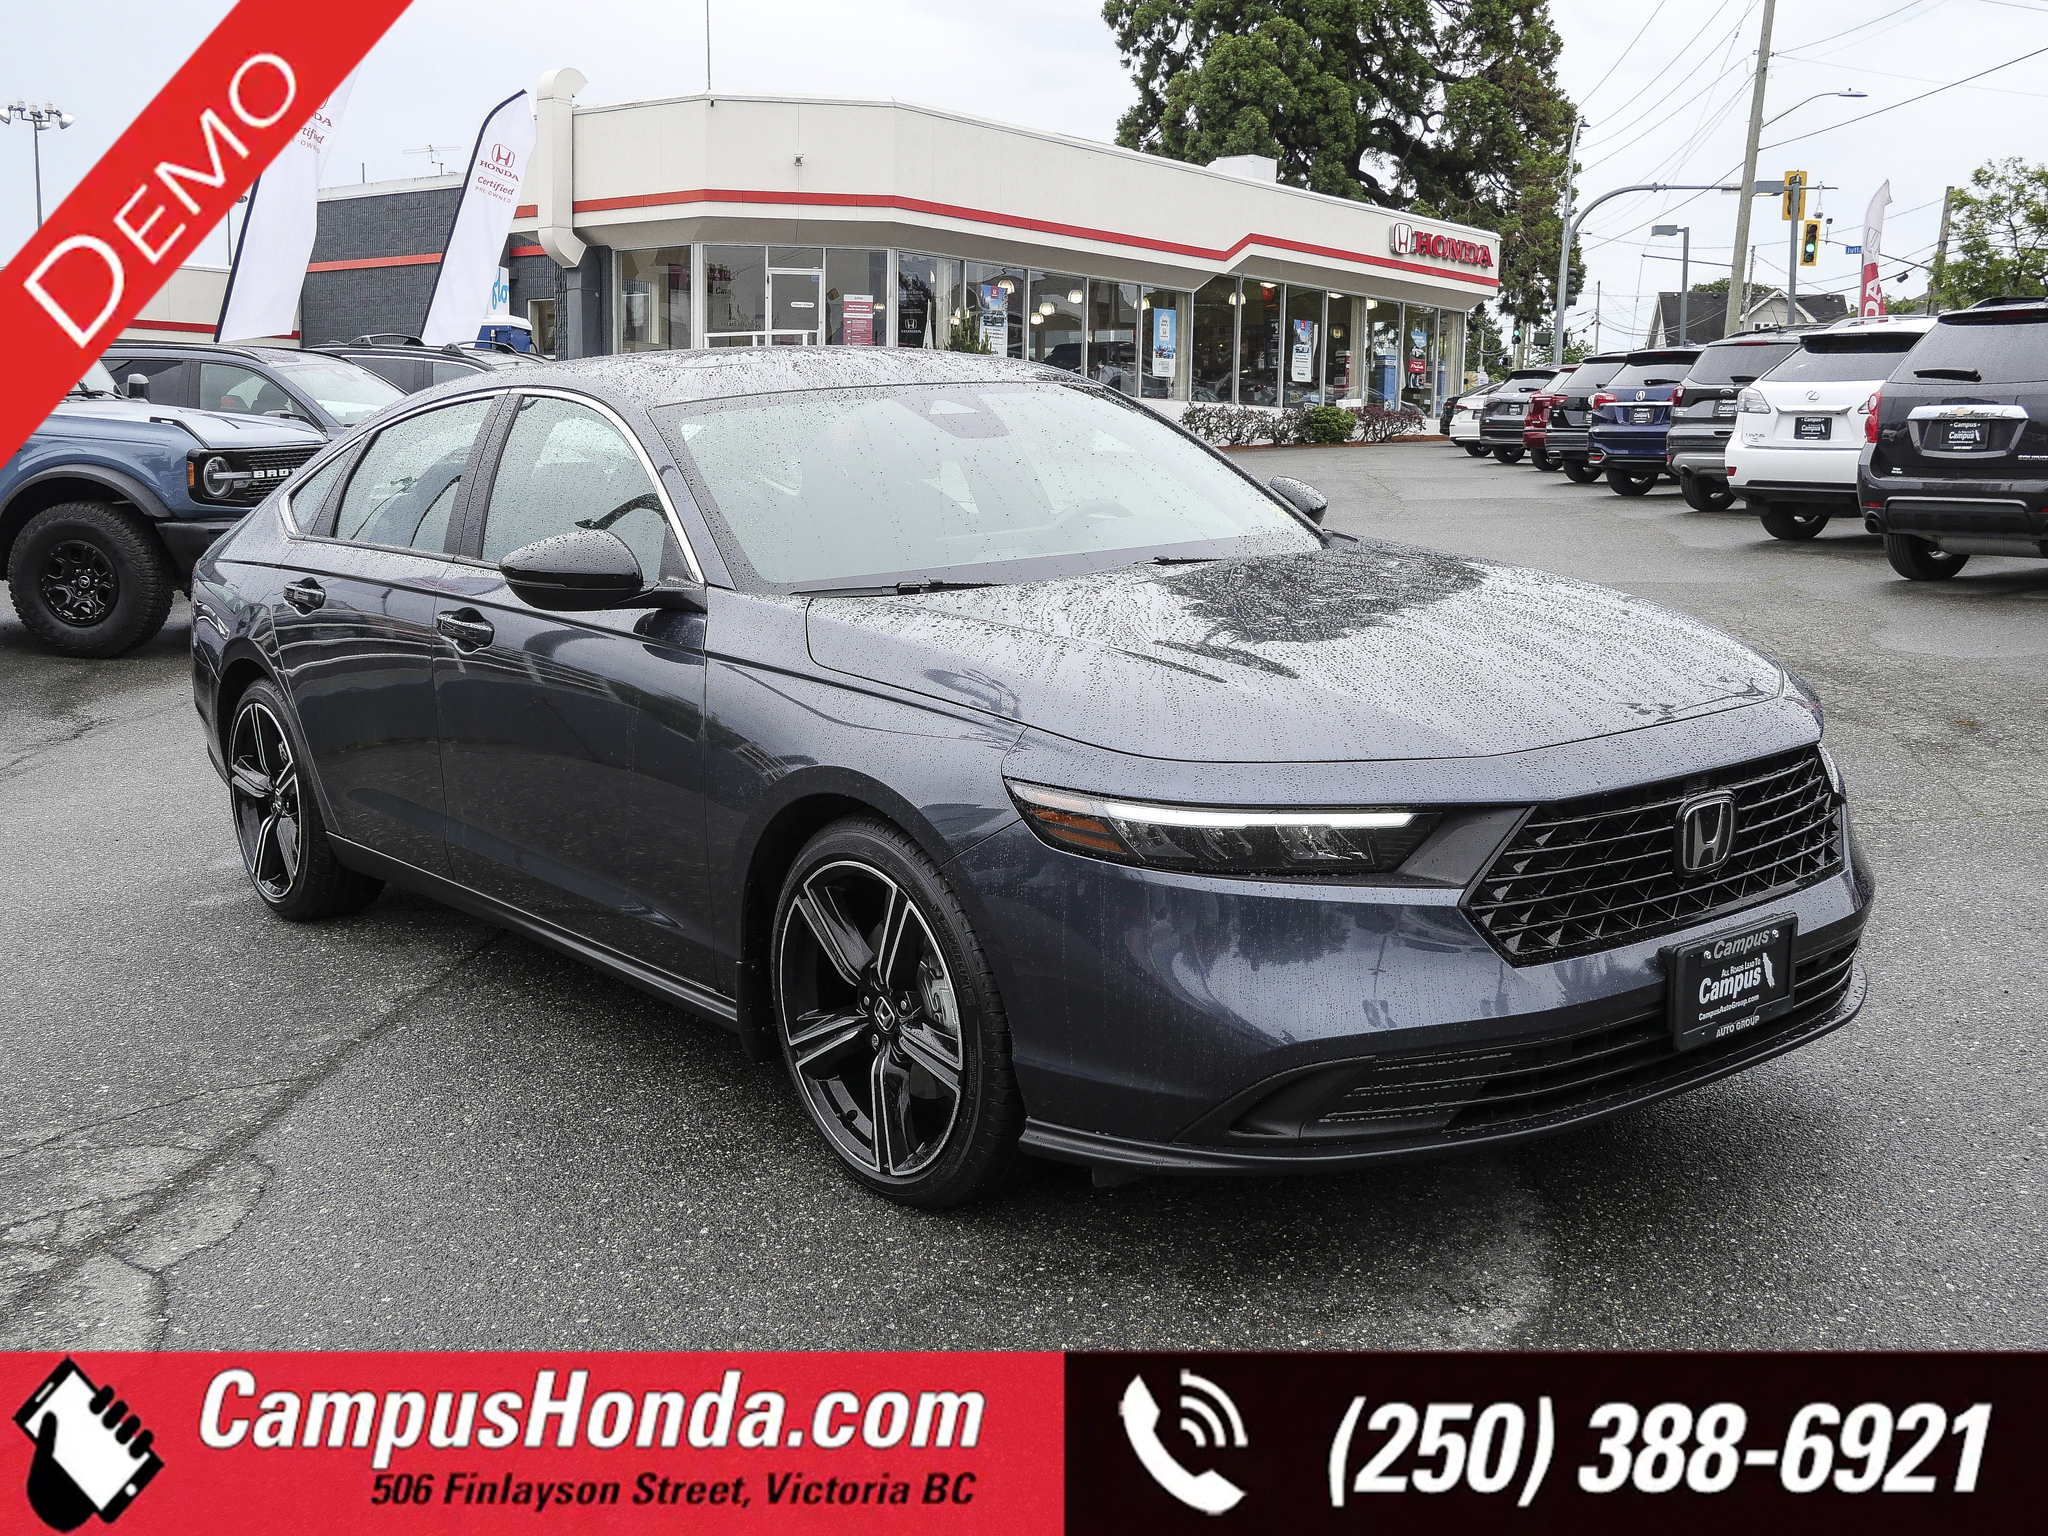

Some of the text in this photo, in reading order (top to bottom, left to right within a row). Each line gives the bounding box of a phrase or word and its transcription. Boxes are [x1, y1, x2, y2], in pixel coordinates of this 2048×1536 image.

[480, 160, 520, 182] HONDA
[475, 186, 512, 203] PRE-OWNED
[477, 176, 515, 196] Certified
[1414, 231, 1494, 267] HONDA
[1948, 431, 1975, 440] Campus
[1713, 930, 1770, 959] Campus
[1721, 967, 1730, 977] ALL
[1699, 967, 1762, 1005] Campus
[1698, 994, 1760, 1021] CampusAutoGroup.com
[1715, 1015, 1760, 1038] AUTO GROUP
